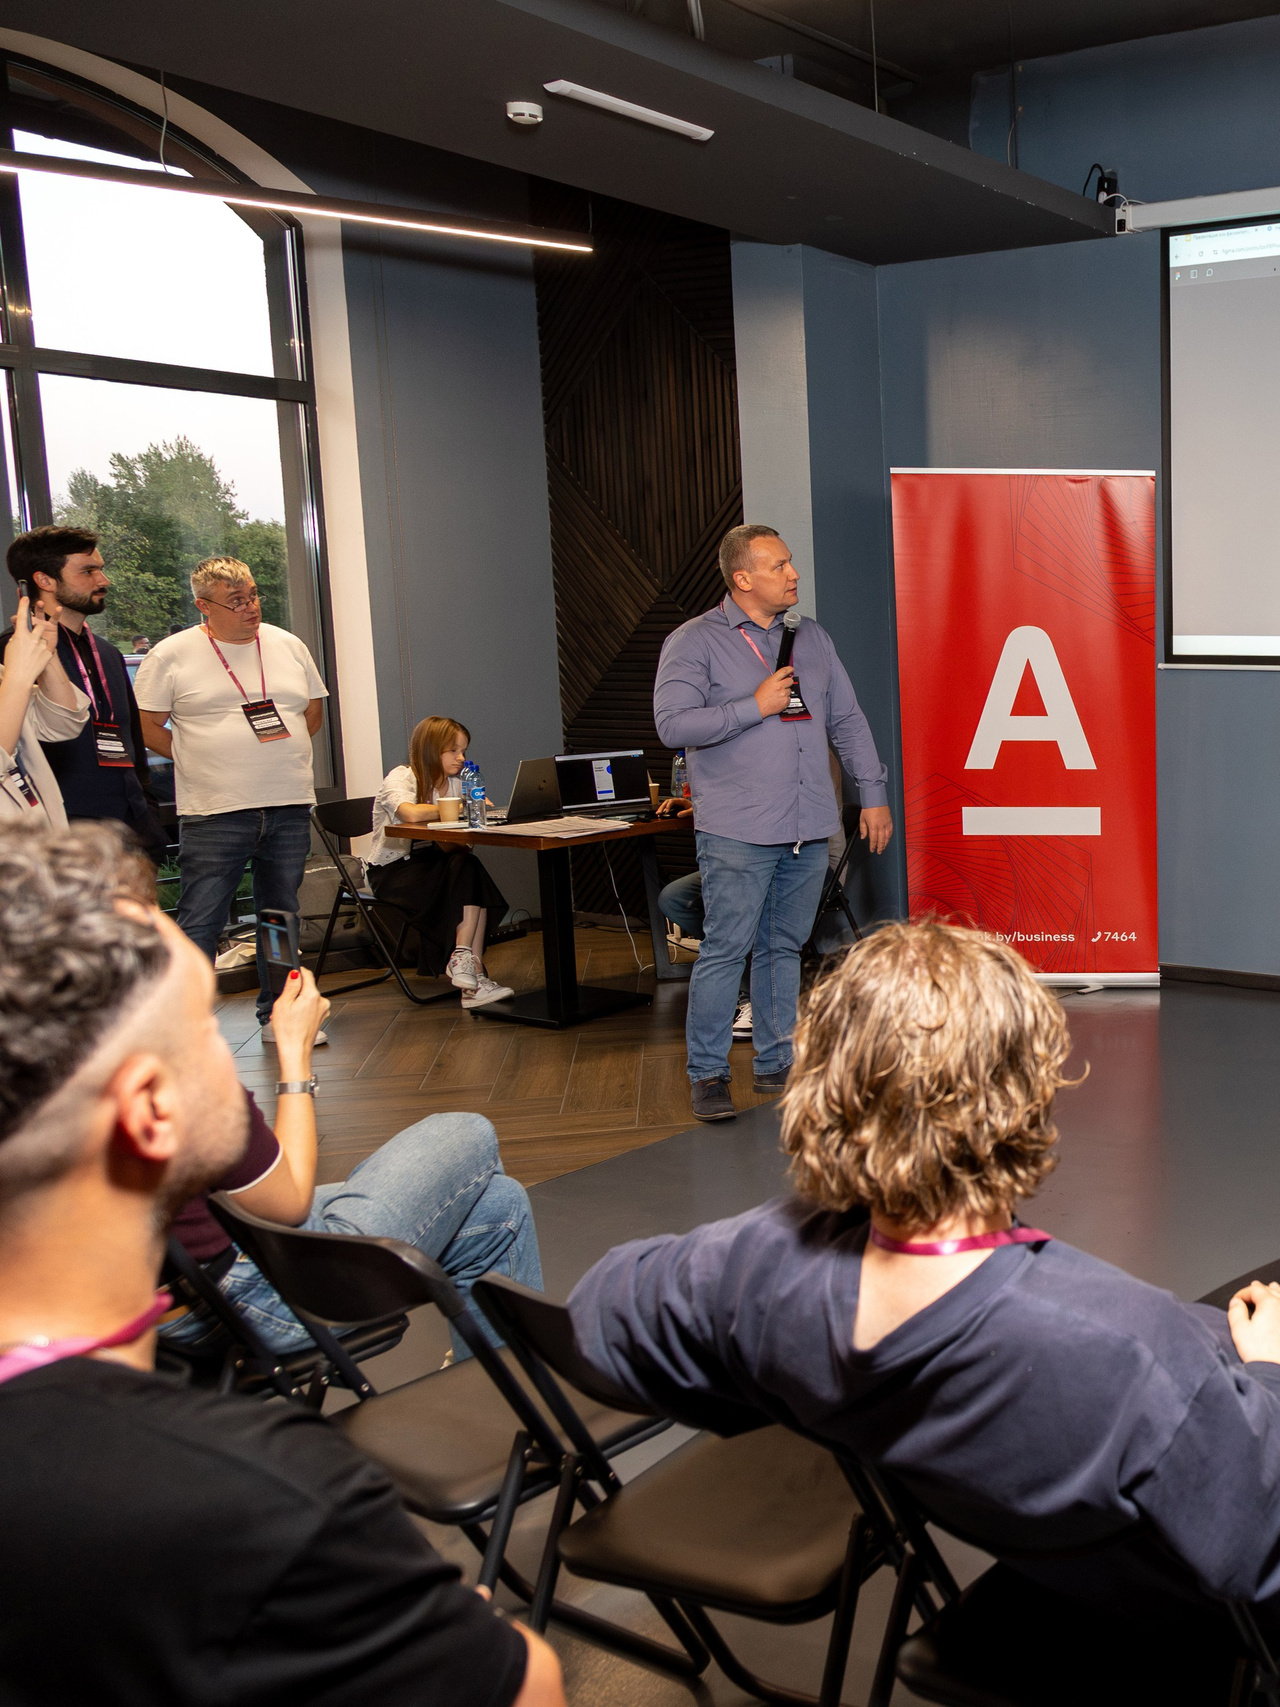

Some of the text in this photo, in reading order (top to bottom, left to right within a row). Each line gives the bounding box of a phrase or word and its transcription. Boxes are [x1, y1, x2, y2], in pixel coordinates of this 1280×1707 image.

[964, 625, 1097, 769] A
[977, 931, 1137, 944] nk.by/business 7464
